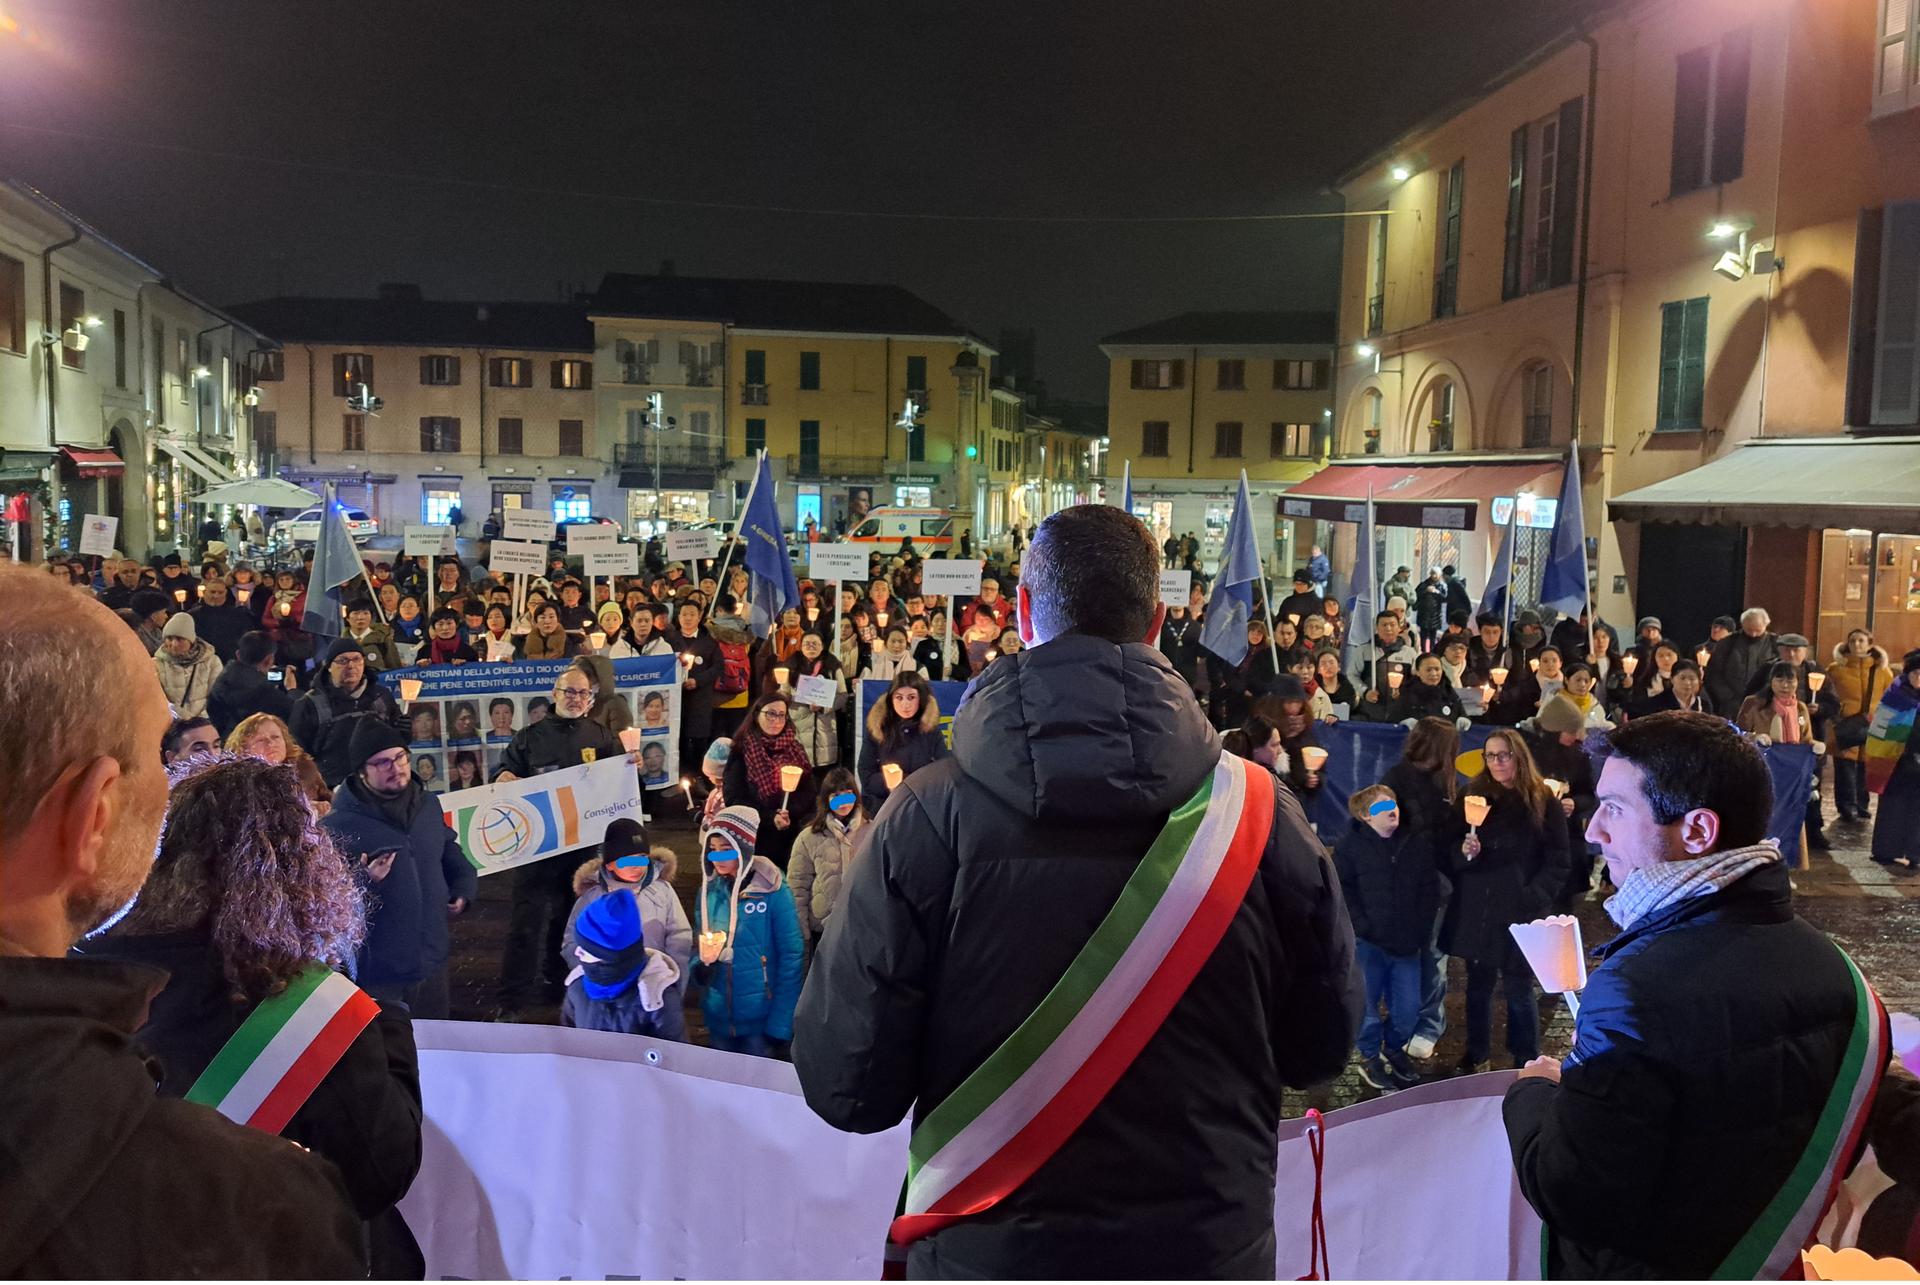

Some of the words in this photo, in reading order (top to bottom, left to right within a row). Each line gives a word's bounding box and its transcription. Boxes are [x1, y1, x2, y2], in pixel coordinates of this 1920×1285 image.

[420, 669, 461, 679] CRISTIANI
[463, 668, 491, 677] DELLA
[493, 666, 524, 675] CHIESA
[526, 665, 535, 673] DI
[536, 665, 551, 673] DIO
[440, 681, 463, 690] PENE
[465, 678, 511, 688] DETENTIVE
[620, 671, 661, 681] CARCERE
[584, 801, 627, 819] Consiglio
